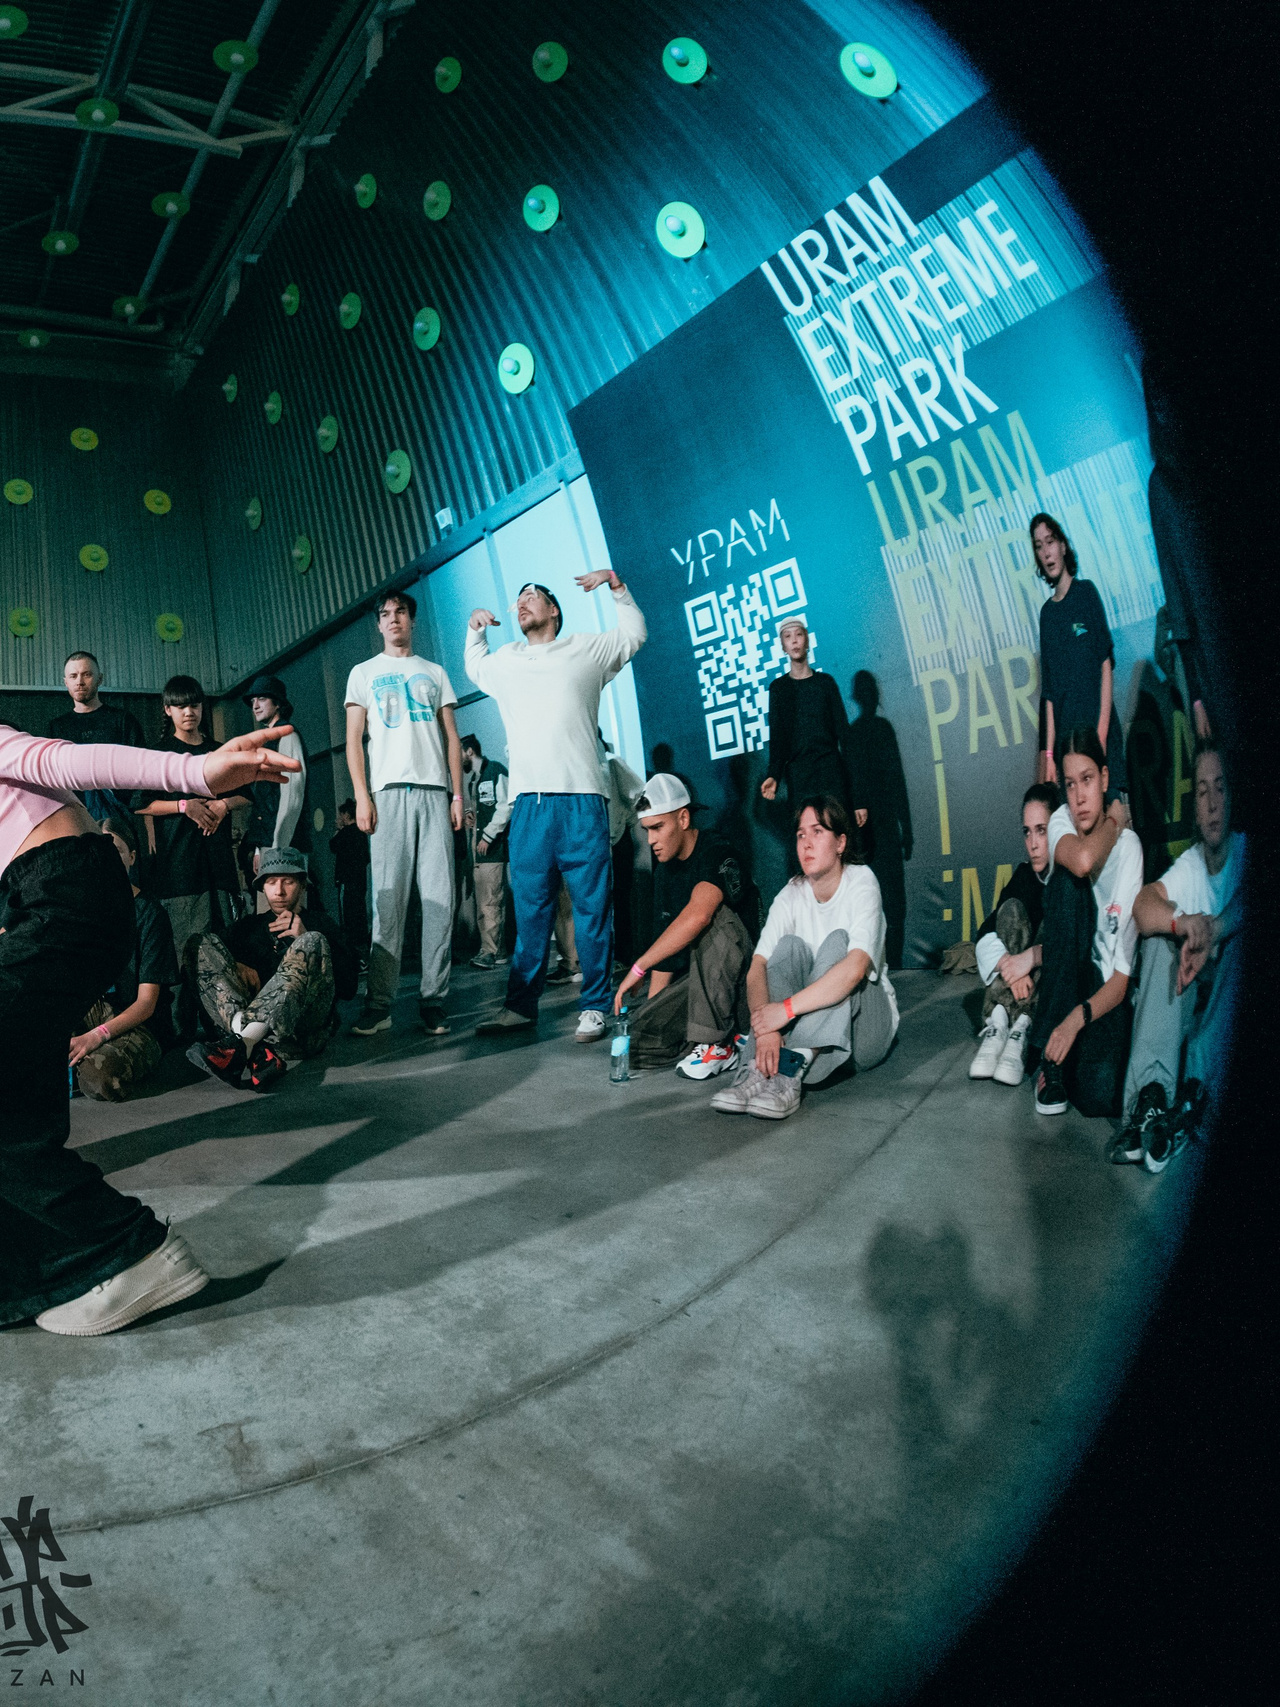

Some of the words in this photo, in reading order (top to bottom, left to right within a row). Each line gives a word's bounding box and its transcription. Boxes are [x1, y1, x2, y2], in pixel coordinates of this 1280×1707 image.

[760, 175, 919, 316] URAM
[798, 200, 1038, 393] EXTREME
[835, 334, 998, 476] PARK
[866, 409, 1052, 556] URAM
[896, 480, 1158, 659] EXTRME
[919, 645, 1040, 761] PAR
